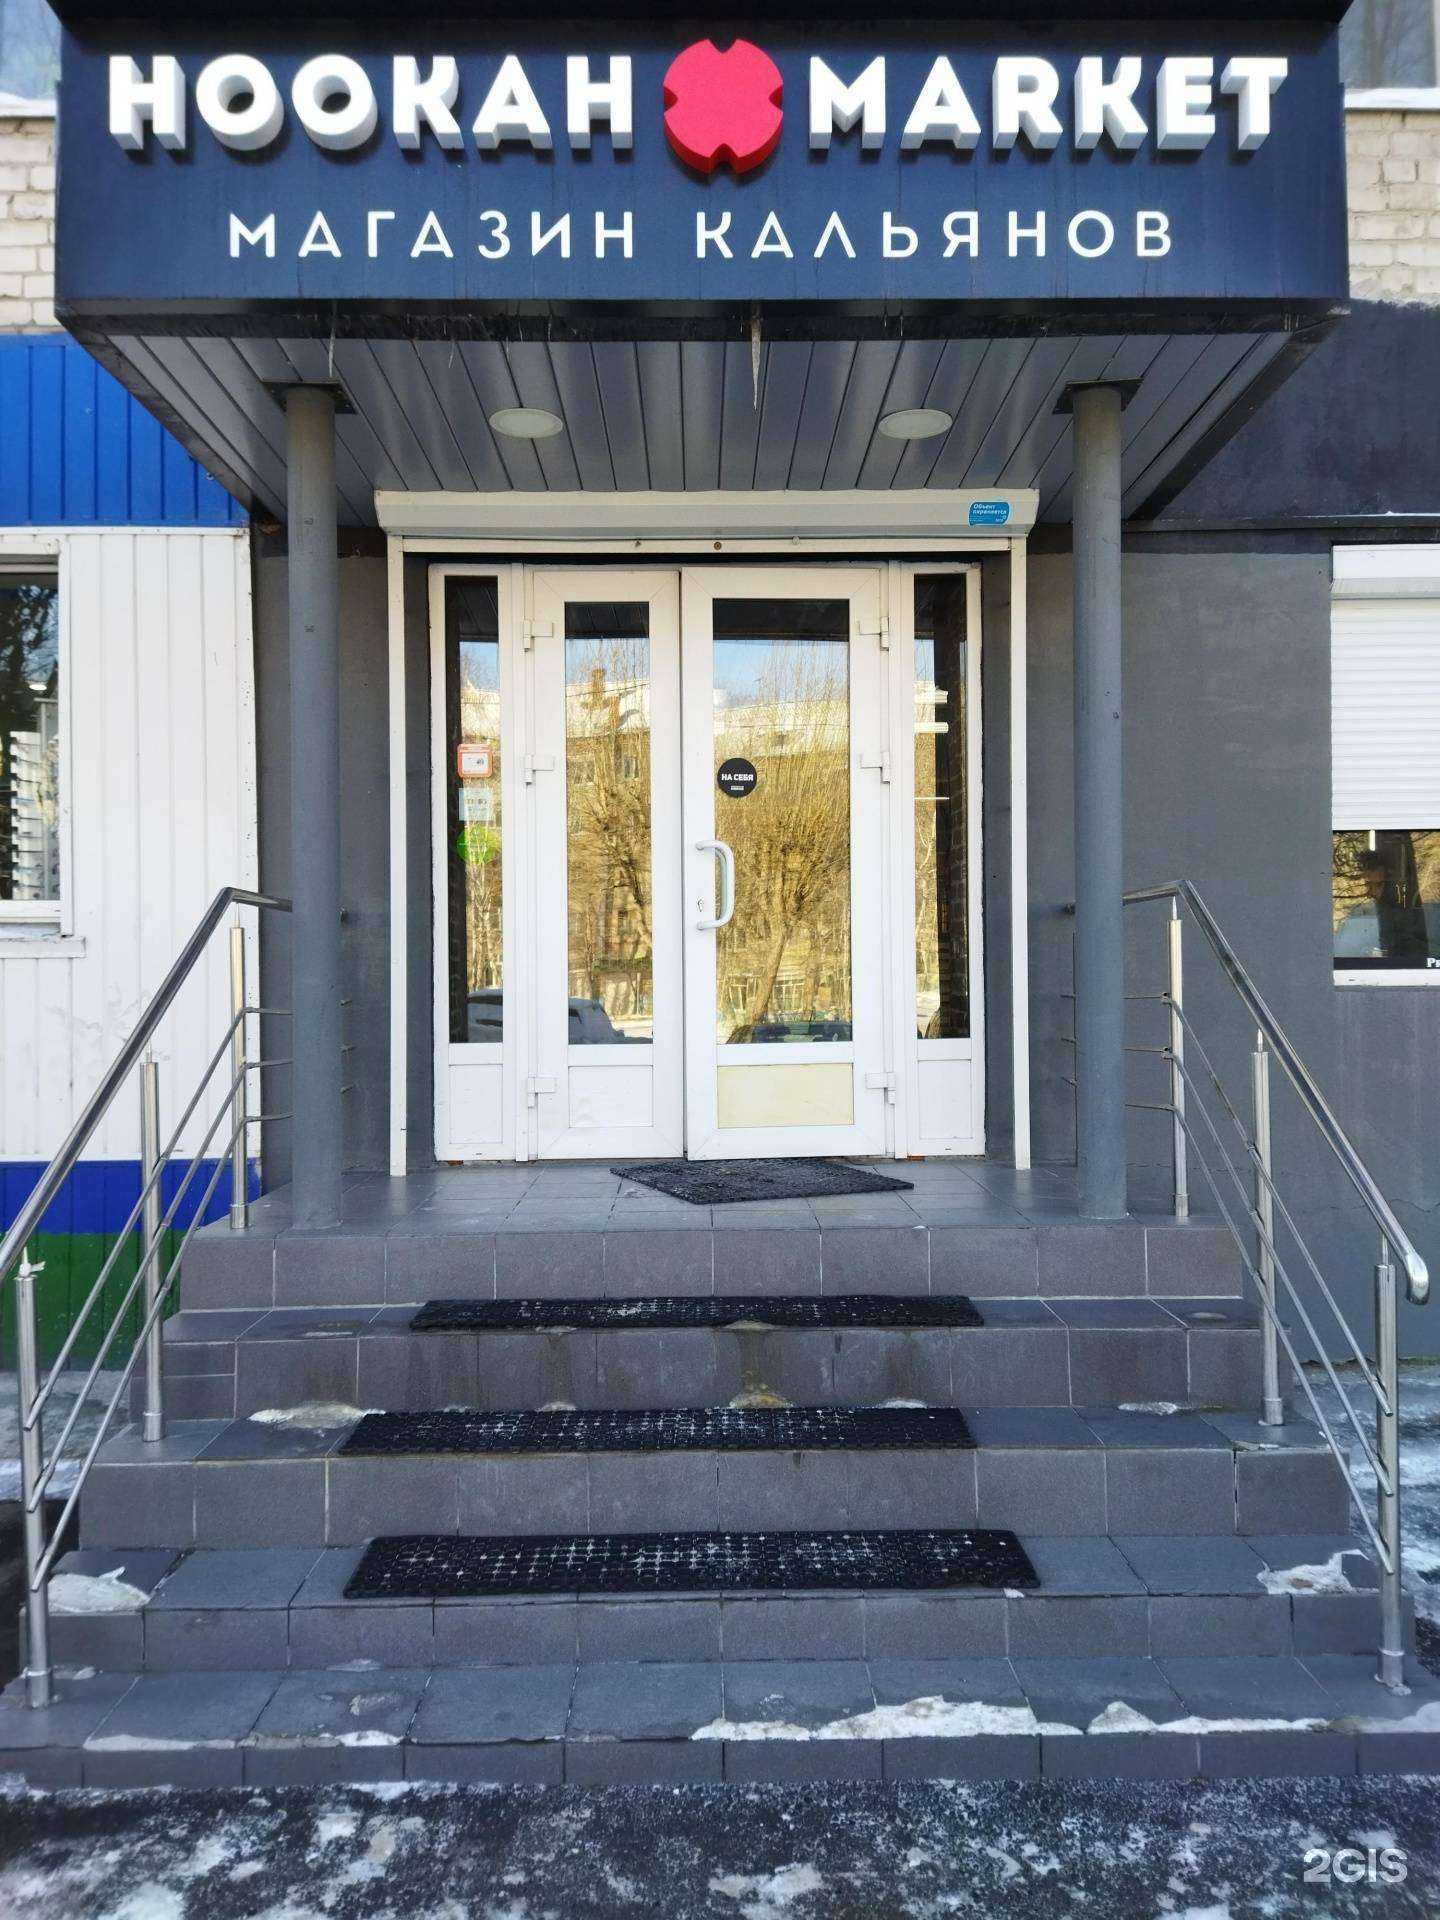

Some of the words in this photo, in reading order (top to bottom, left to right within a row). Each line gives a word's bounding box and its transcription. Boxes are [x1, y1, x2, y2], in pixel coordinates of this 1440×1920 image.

[108, 53, 635, 151] HOOKAH
[808, 55, 1289, 151] MARKET
[229, 210, 635, 260] МАГАЗИН
[695, 210, 1174, 260] КАЛЬЯНОВ
[721, 773, 733, 781] НА
[733, 773, 754, 781] СЕБЯ
